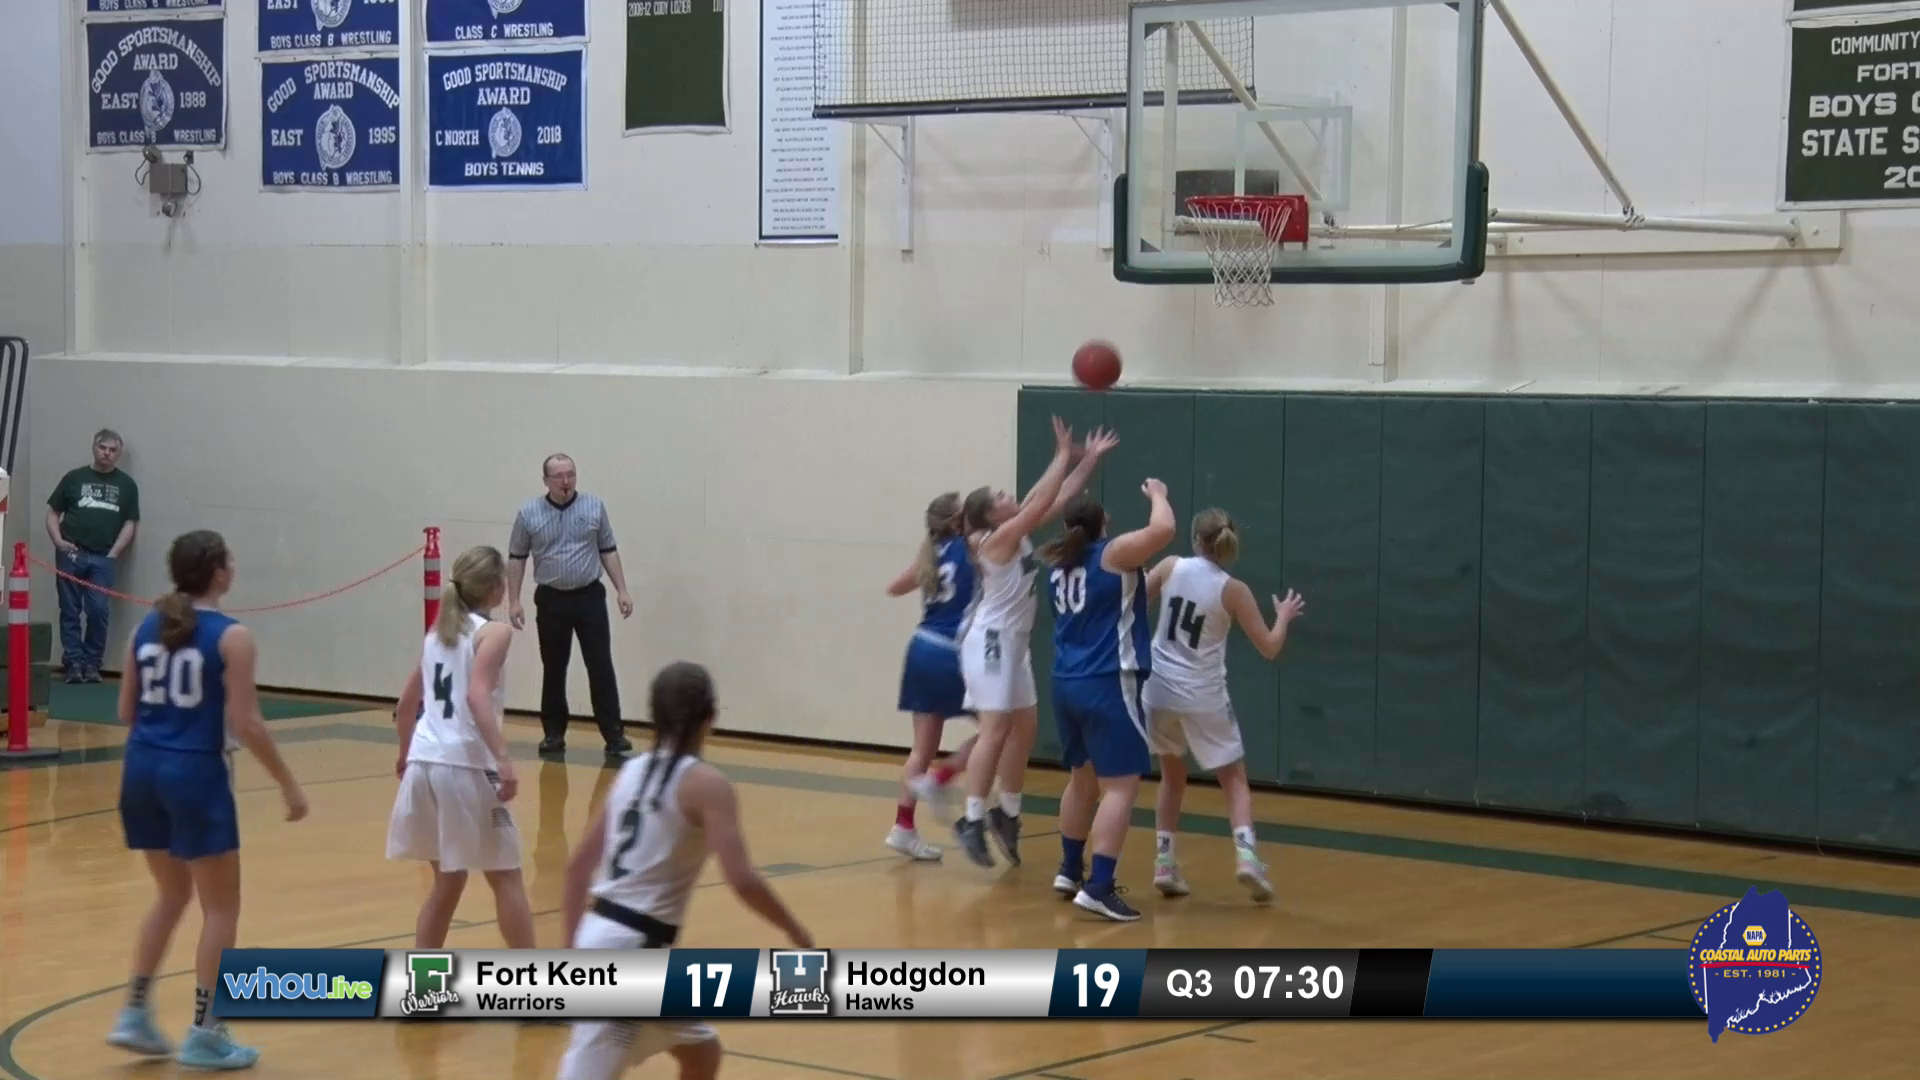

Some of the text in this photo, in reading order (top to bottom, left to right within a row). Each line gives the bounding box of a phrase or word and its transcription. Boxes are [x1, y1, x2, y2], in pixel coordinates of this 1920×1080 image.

[270, 31, 392, 49] BOYS CLASS B WRESTLING
[455, 22, 554, 40] CLASS C WRESTLING
[1831, 31, 1920, 55] COMMUNITY
[91, 26, 221, 94] GOOD SPORTSMANSHIP
[133, 53, 179, 71] AWARD
[443, 62, 567, 92] GOOD SPORTSMANSHIP
[1857, 62, 1920, 83] FORT
[267, 61, 400, 113] GOOD SPORTSMANSHIP
[313, 81, 354, 100] AWARD
[477, 87, 531, 106] AWARD
[101, 92, 139, 110] EAST
[1809, 92, 1897, 118] BOYS
[97, 131, 116, 144] BOYS
[119, 130, 145, 143] CLASS
[174, 128, 216, 142] WRESTLING
[271, 129, 303, 147] EAST
[368, 126, 396, 145] 1995
[435, 129, 480, 146] C NORTH
[537, 126, 562, 145] 2018
[1801, 127, 1888, 157] STATE
[273, 170, 392, 185] BOYS CLASS B WRESTLING
[465, 162, 544, 177] BOYS TENNIS
[1050, 566, 1087, 614] 30
[1167, 596, 1206, 650] 14
[137, 643, 204, 708] 20
[434, 663, 455, 719] 4
[611, 808, 642, 880] 2
